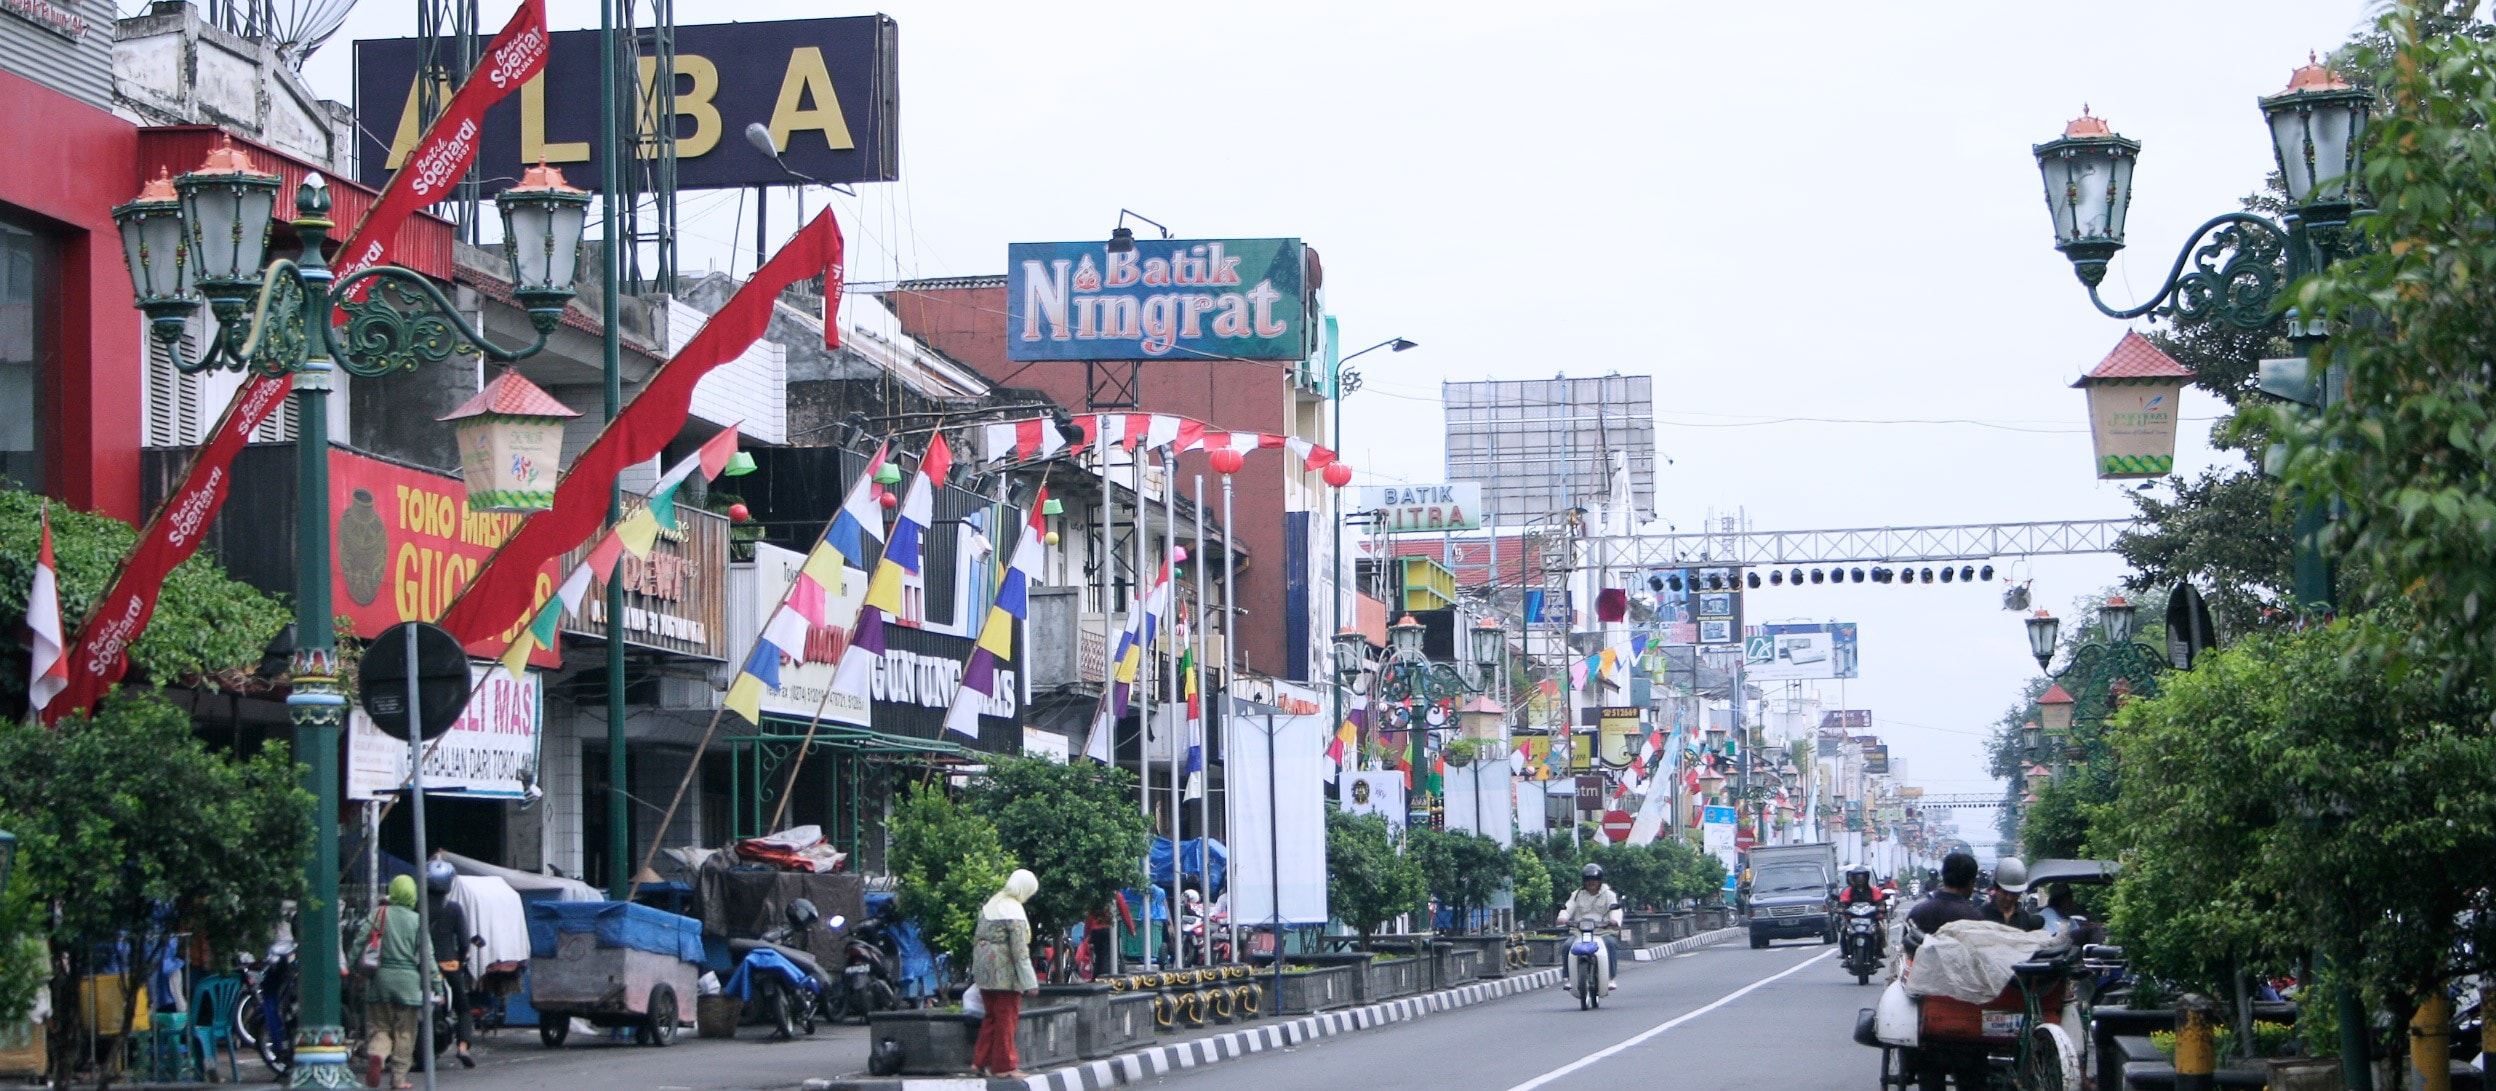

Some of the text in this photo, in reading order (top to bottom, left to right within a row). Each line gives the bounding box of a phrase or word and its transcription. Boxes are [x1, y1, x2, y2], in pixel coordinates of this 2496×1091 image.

[495, 32, 525, 65] Batik
[512, 57, 535, 80] SEJAK
[385, 46, 854, 170] ALBA
[412, 118, 478, 196] Soenardi
[416, 138, 448, 175] Batik
[437, 144, 471, 188] SEJAK 1957
[1104, 243, 1242, 288] Batik
[1021, 258, 1287, 354] Ningrat
[168, 466, 223, 548] Soenardi
[170, 490, 200, 527] Batik
[396, 484, 456, 540] TOKO
[1384, 486, 1454, 505] BATIK
[88, 595, 144, 677] Soenardi
[494, 679, 532, 737] MAS
[870, 649, 1016, 719] GUNUNG AS
[470, 748, 491, 780] DARI
[493, 749, 514, 780] TOKO
